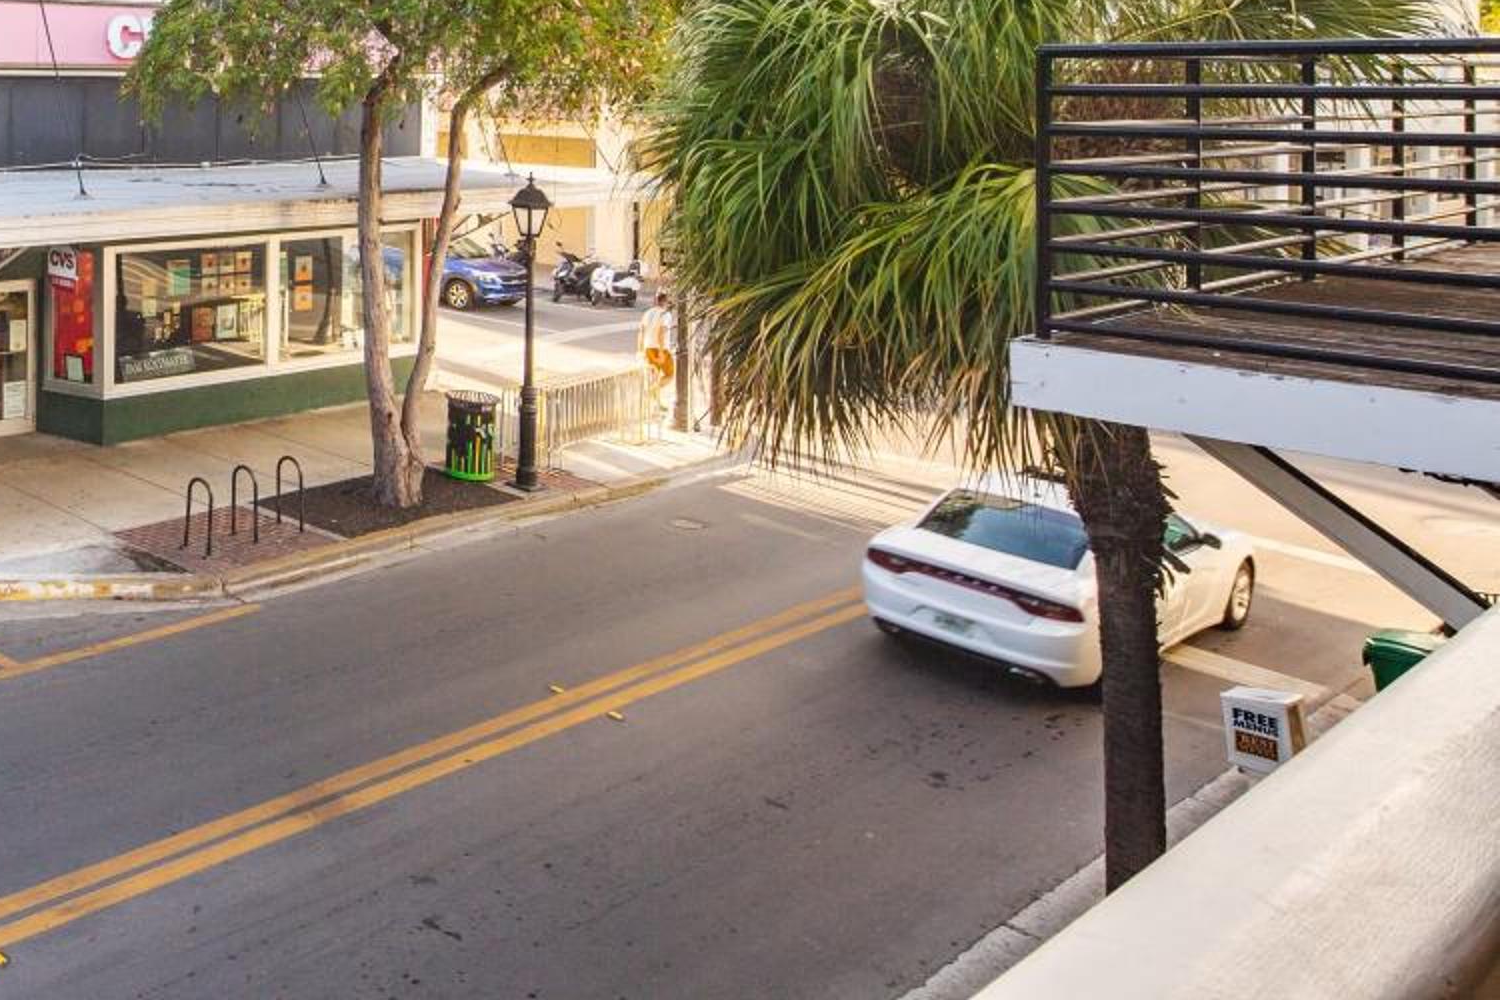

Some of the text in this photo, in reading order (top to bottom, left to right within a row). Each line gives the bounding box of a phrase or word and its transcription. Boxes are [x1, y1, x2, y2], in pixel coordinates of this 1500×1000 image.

[50, 249, 75, 270] CVS
[1232, 708, 1278, 730] FREE
[1232, 719, 1279, 737] MENUS
